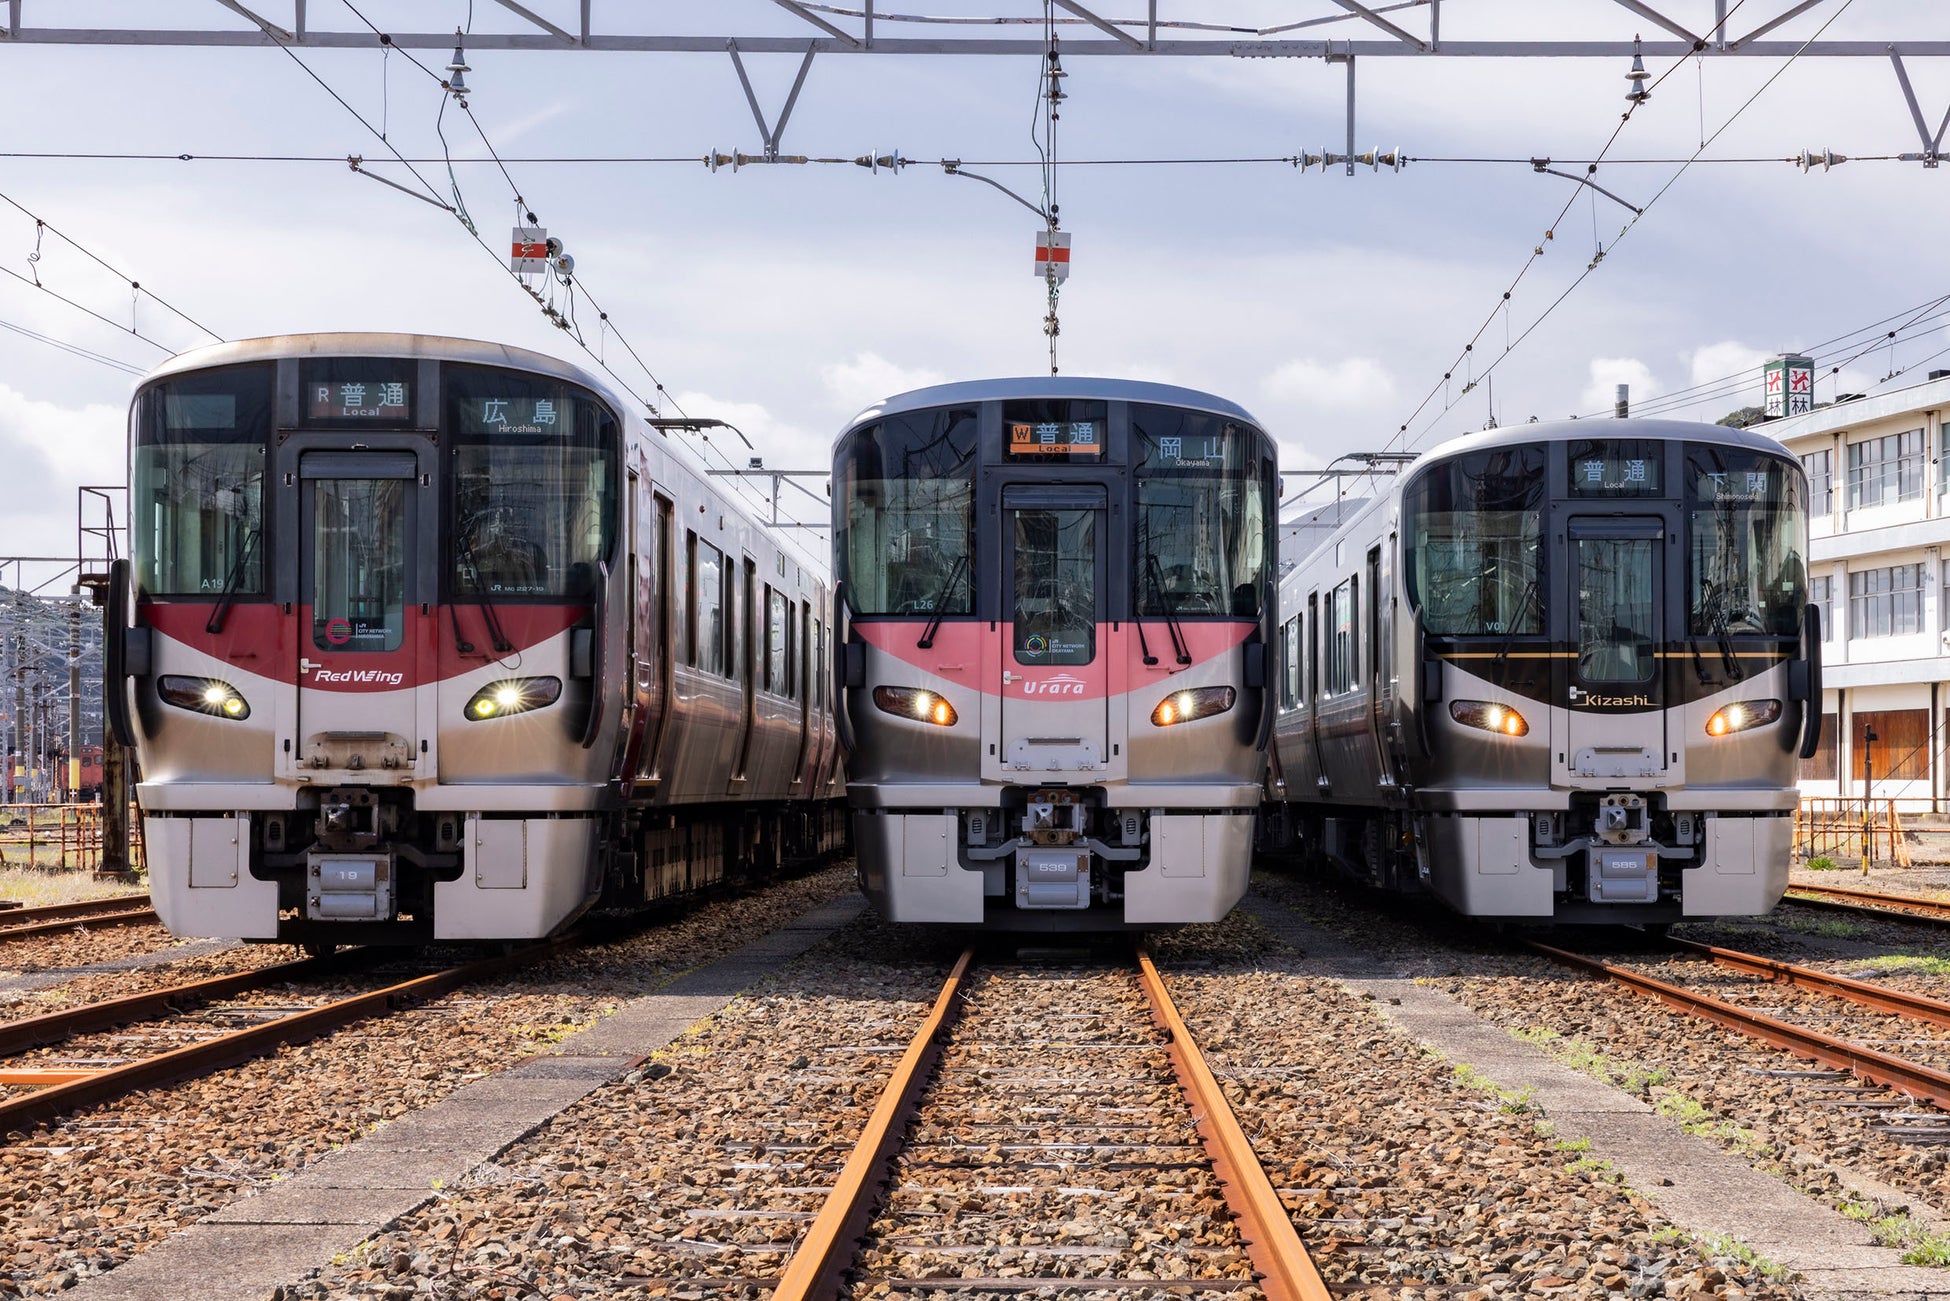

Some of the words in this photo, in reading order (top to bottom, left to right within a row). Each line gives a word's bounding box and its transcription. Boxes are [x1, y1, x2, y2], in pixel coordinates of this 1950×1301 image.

[318, 387, 329, 402] R
[340, 382, 404, 407] 普通
[1791, 396, 1809, 415] 林
[343, 407, 380, 416] Local
[482, 398, 557, 425] 広島
[498, 424, 541, 433] Hiroshima
[1014, 426, 1029, 441] W
[1036, 422, 1094, 444] 普通
[1160, 436, 1226, 460] 岡山
[1175, 459, 1210, 467] Okayama
[1583, 459, 1646, 482] 普通
[1604, 481, 1625, 489] Local
[1707, 472, 1767, 493] 下関
[913, 600, 934, 610] L26
[1486, 621, 1505, 631] V01
[1024, 681, 1084, 694] Urara
[1585, 694, 1648, 706] Kizashi
[1039, 863, 1067, 872] 539
[1611, 861, 1638, 869] 585
[339, 871, 358, 880] 19
